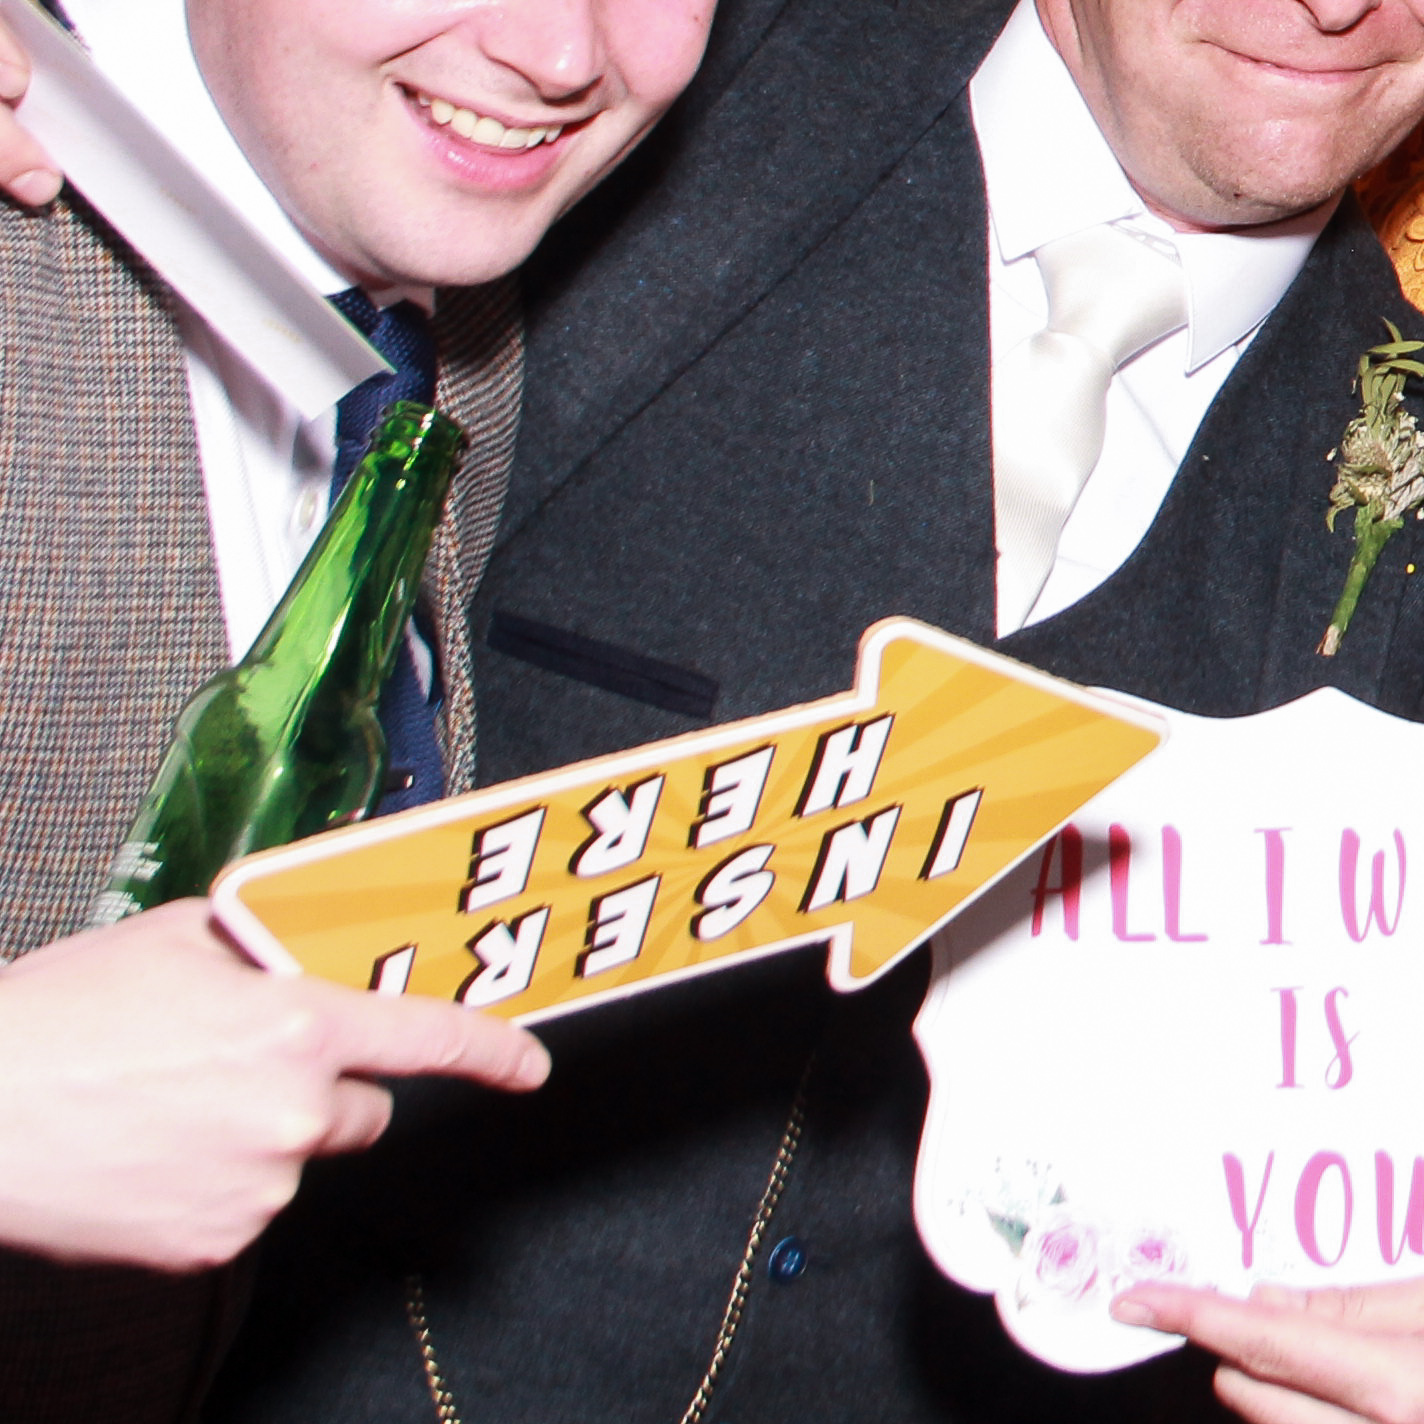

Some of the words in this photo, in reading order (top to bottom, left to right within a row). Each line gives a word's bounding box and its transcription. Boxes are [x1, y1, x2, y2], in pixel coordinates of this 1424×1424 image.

[457, 712, 896, 914] HERE
[1030, 822, 1208, 942] ALL
[1254, 826, 1293, 945] I
[1269, 986, 1361, 1090] IS
